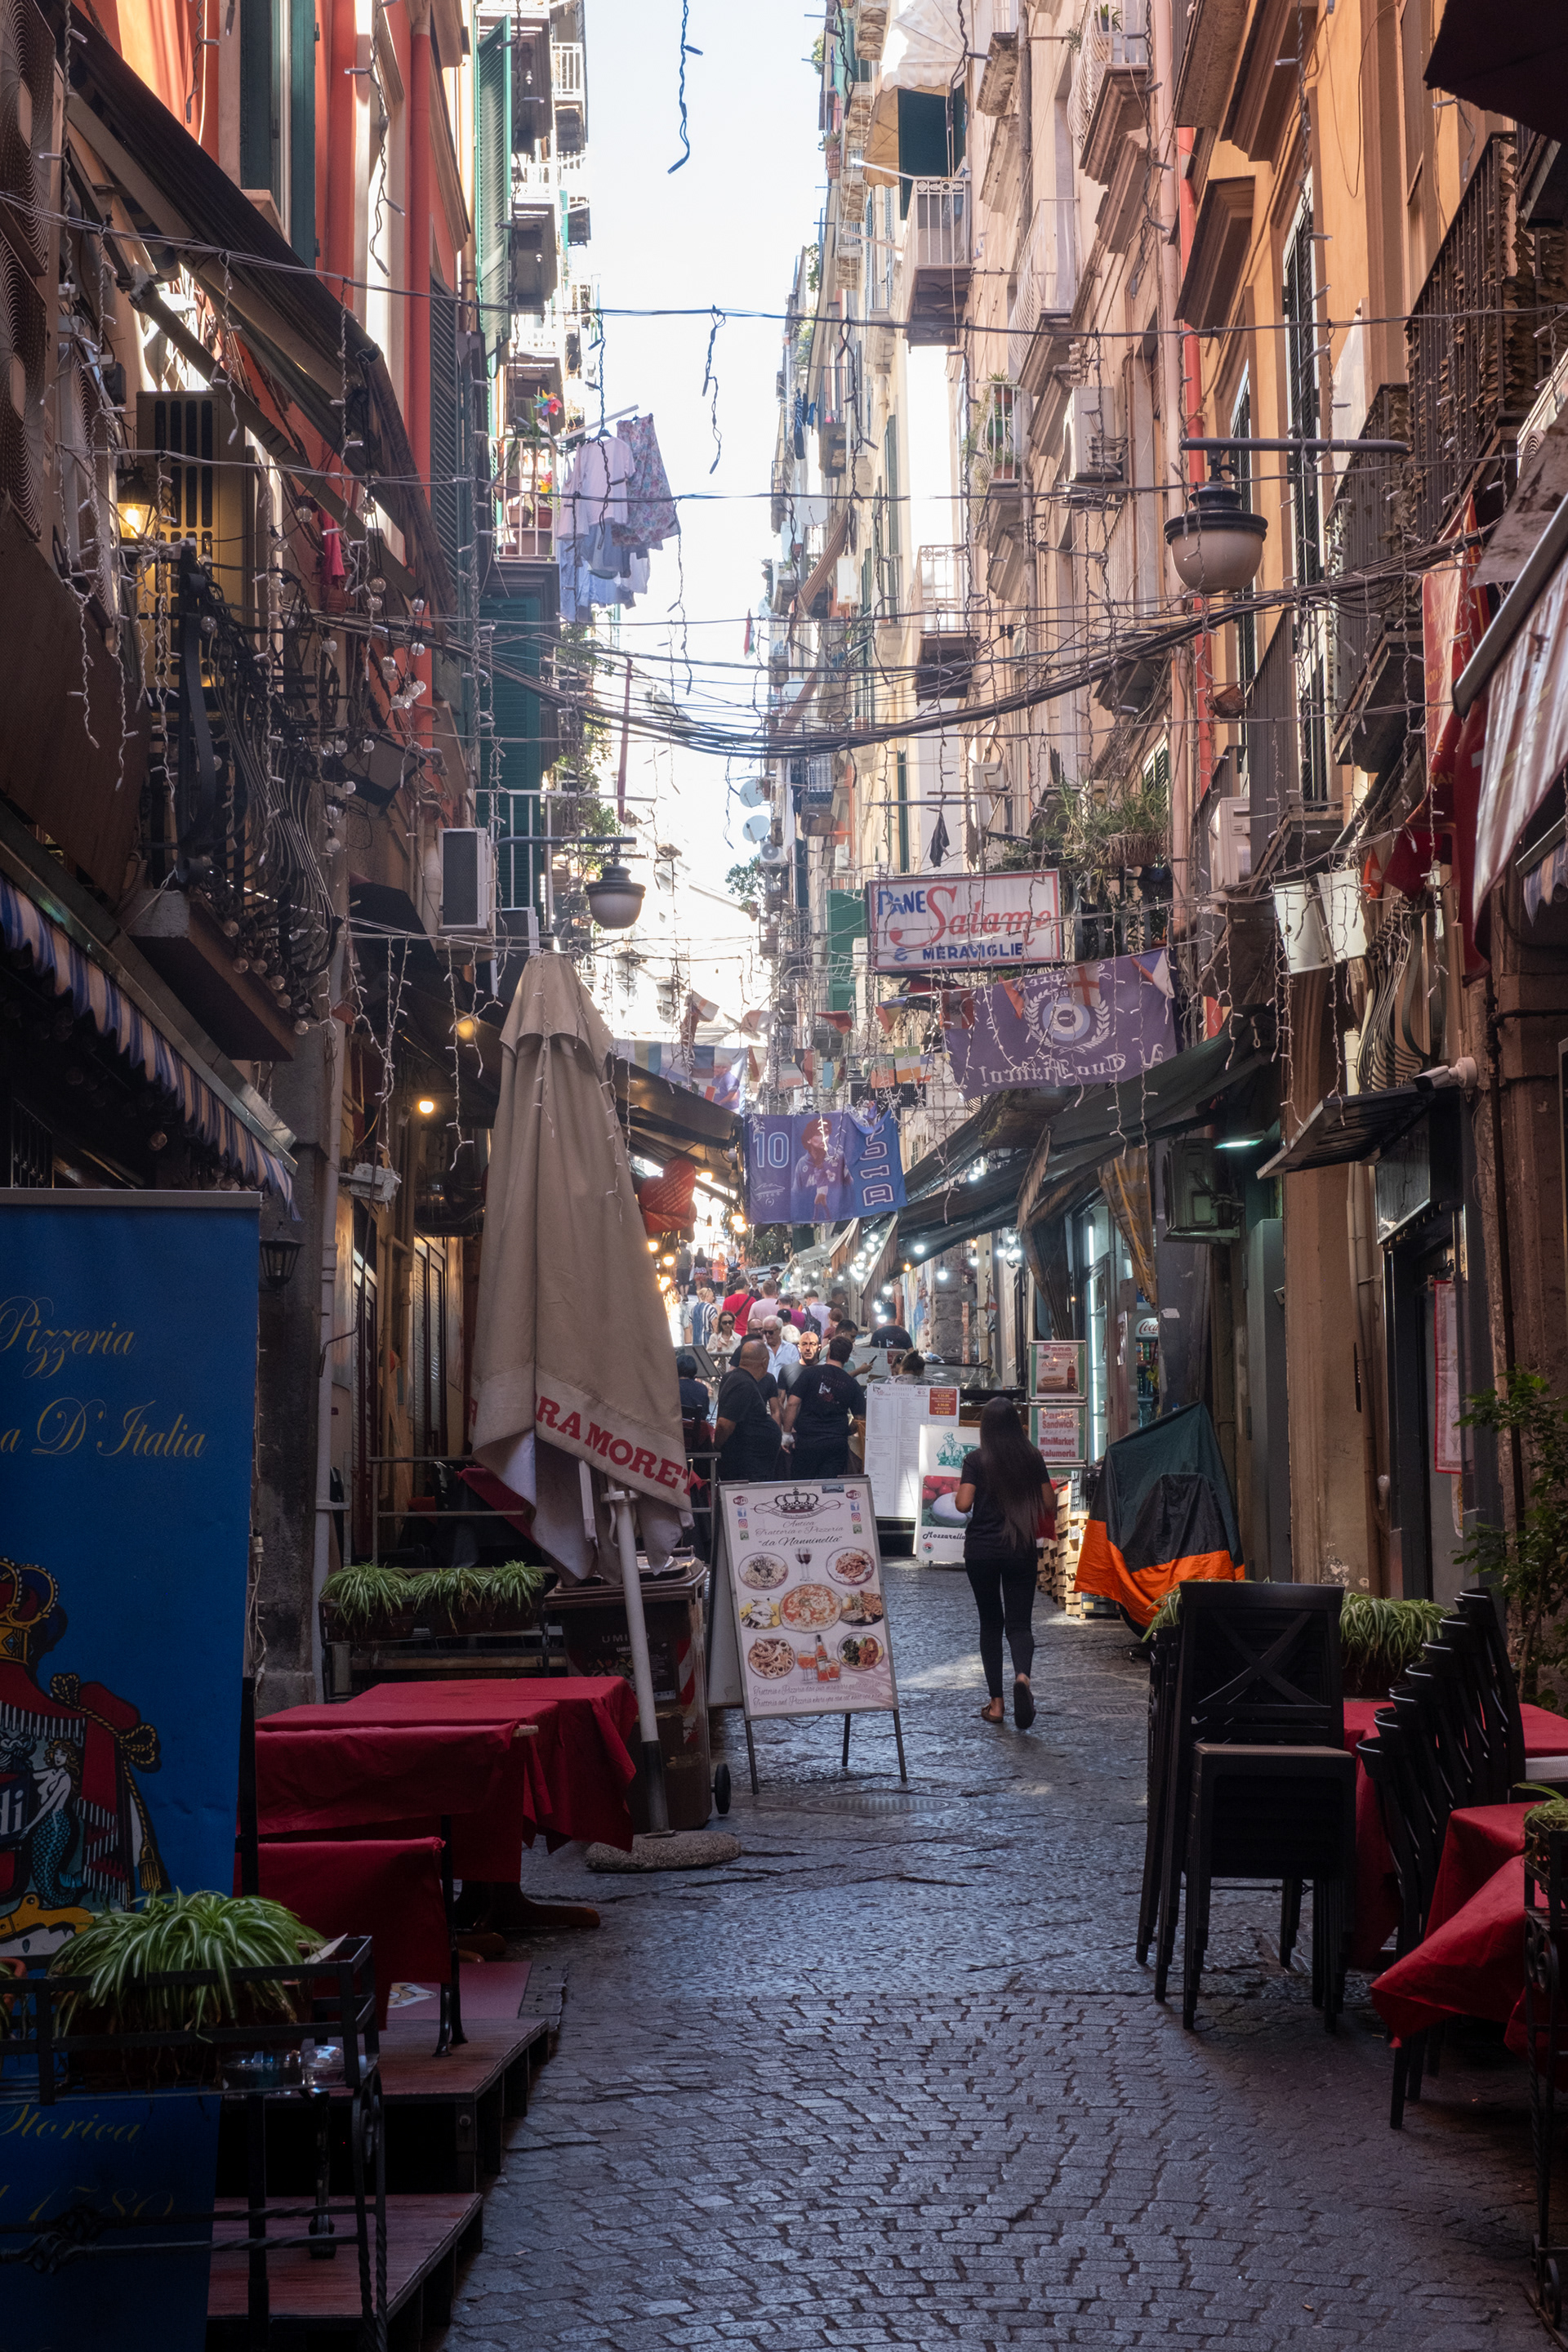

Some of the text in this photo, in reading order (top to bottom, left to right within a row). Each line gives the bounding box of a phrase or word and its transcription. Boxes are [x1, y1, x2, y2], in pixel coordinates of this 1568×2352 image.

[877, 890, 926, 915] PANE
[889, 885, 1051, 948] Salame
[923, 942, 1024, 960] MERAVIGLIE
[753, 1131, 790, 1169] 10
[859, 1124, 894, 1207] D10
[0, 1295, 137, 1379] Pizzeria
[1042, 1411, 1074, 1419] Panini
[1042, 1420, 1074, 1429] Sandwich
[1040, 1437, 1076, 1446] MiniMarket
[1041, 1449, 1076, 1458] Salumeria
[783, 1520, 815, 1528] Antica
[755, 1528, 795, 1536] Trattoria
[804, 1526, 844, 1535] Pizzeria
[923, 1531, 967, 1540] Mozzarella
